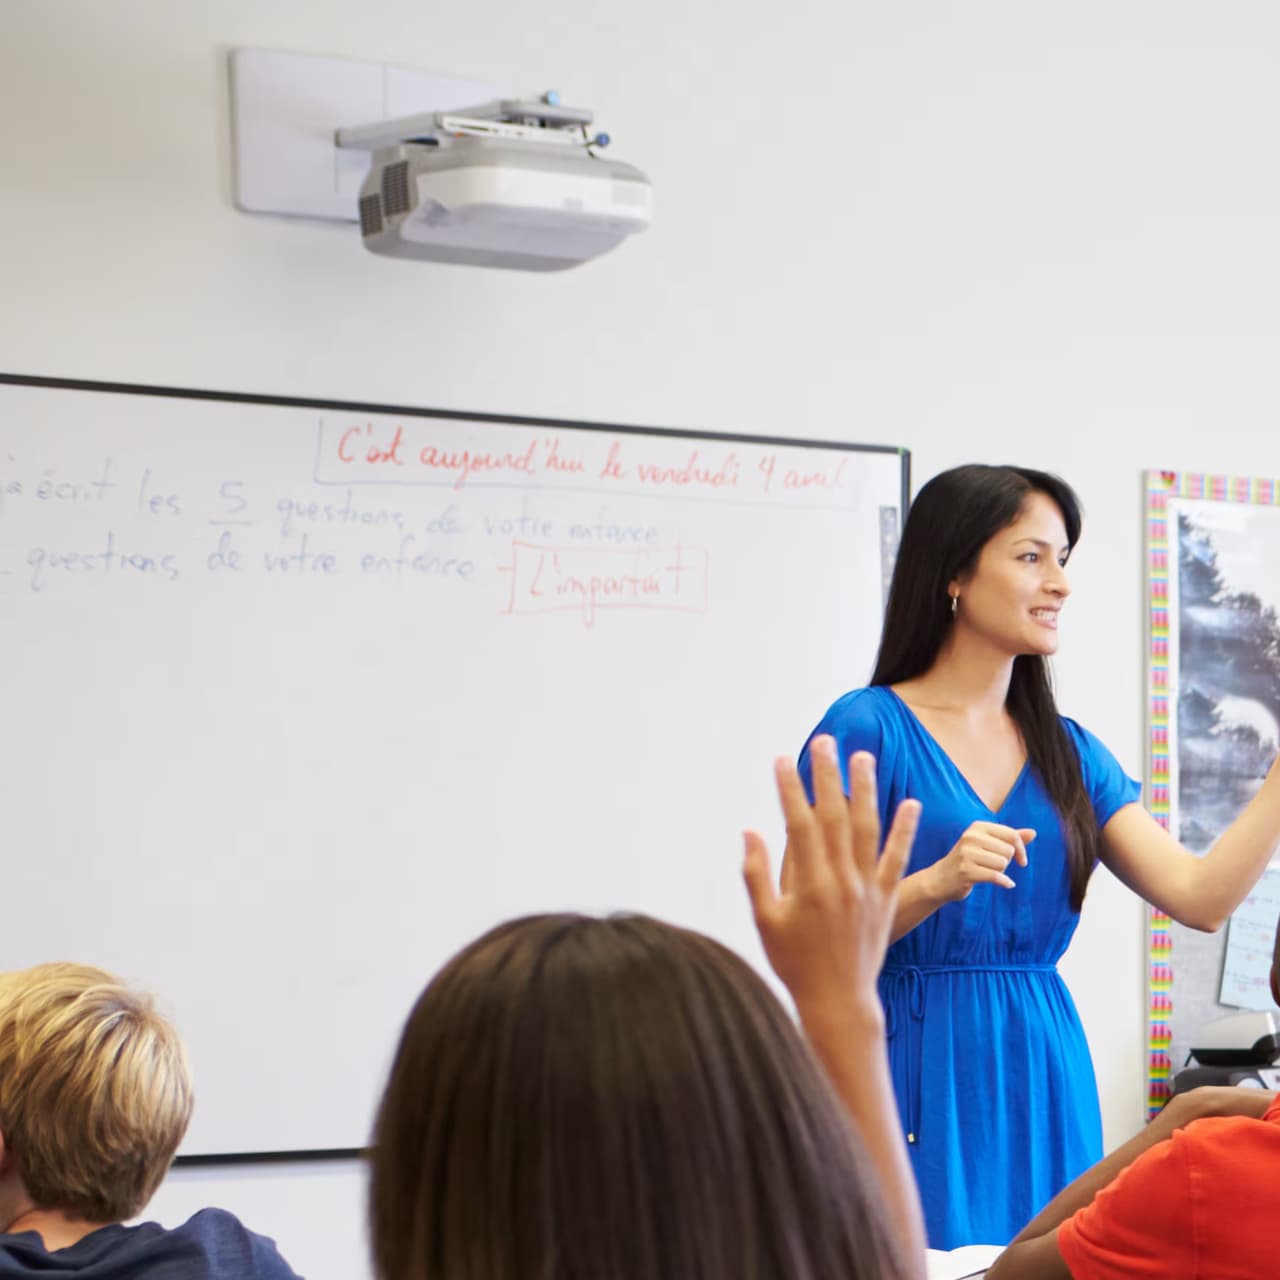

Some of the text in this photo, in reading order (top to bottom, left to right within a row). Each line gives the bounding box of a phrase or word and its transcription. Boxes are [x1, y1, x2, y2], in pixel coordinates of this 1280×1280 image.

[337, 422, 404, 466] C'est
[598, 440, 628, 480] le
[636, 450, 741, 488] vendredi
[757, 454, 776, 496] 4
[783, 456, 849, 489] avril
[137, 467, 182, 517] les
[275, 487, 404, 538] questions
[426, 503, 462, 535] de
[484, 495, 552, 537] votre
[26, 529, 475, 592] questions de votre enfance
